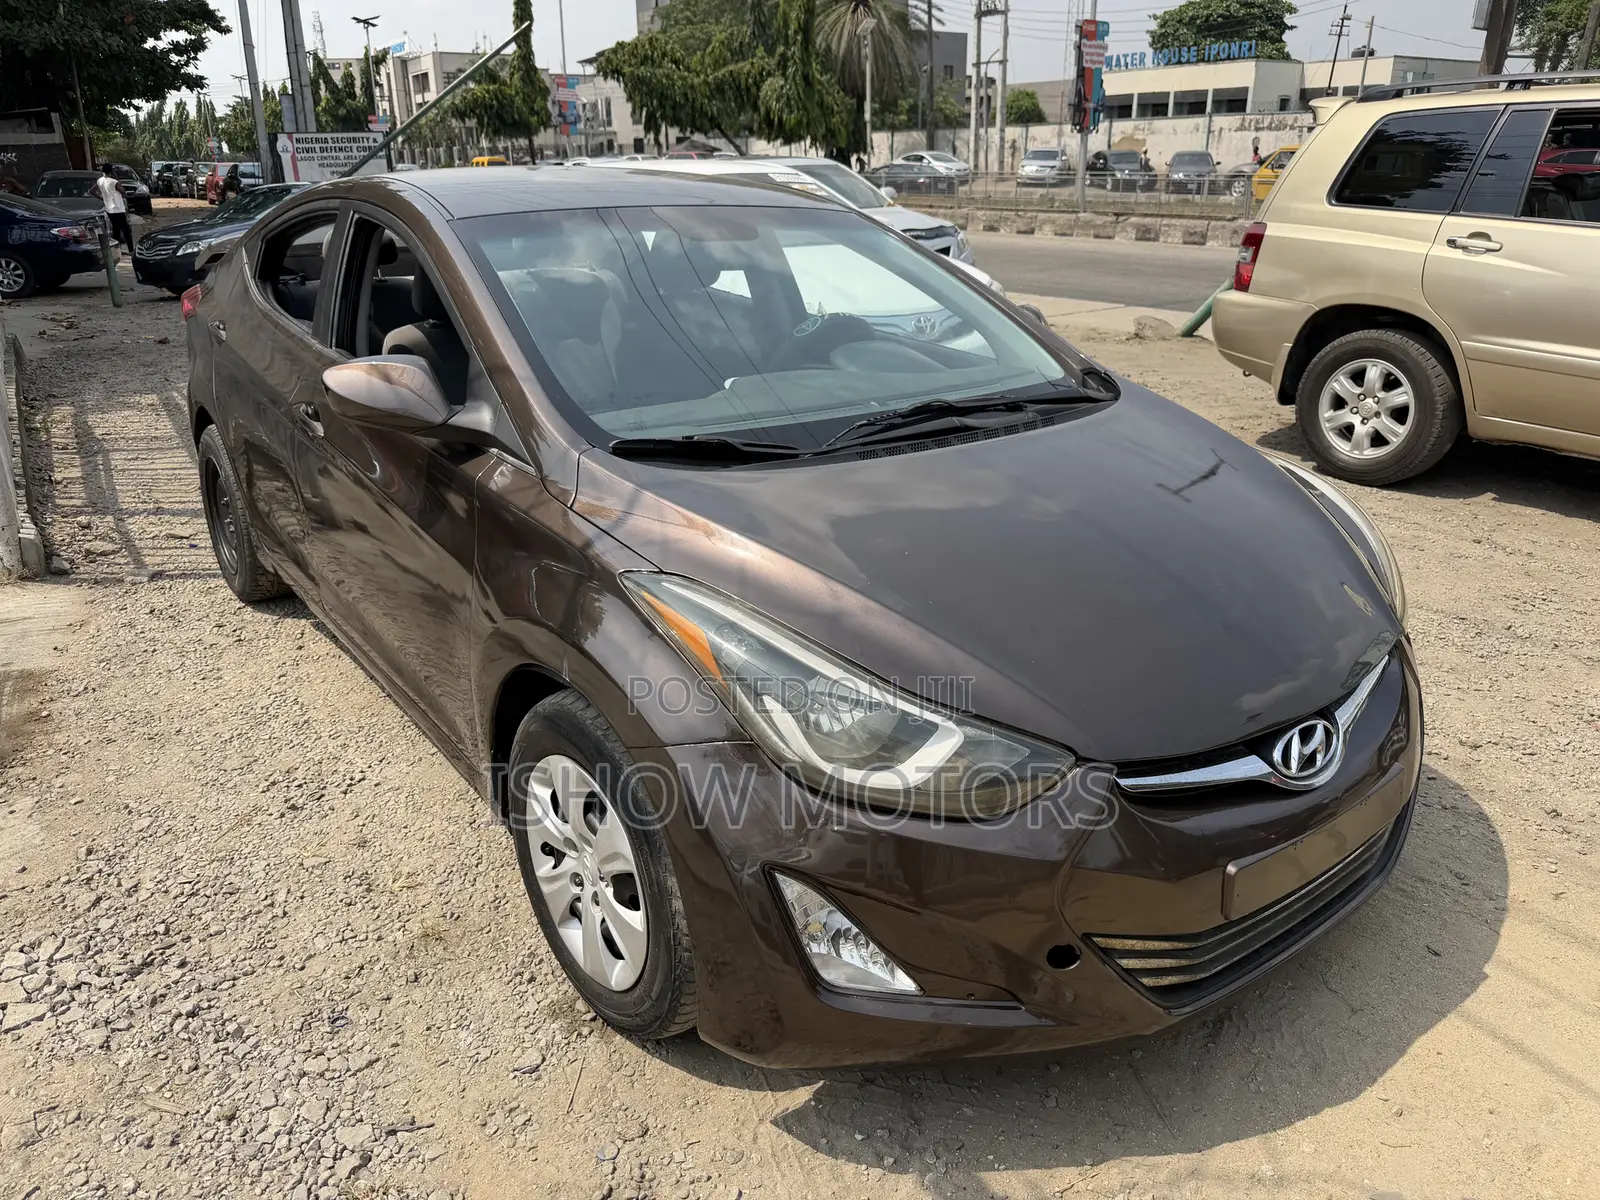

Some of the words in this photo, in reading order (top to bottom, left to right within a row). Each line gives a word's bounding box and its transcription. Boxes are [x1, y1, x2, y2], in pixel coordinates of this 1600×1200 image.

[1104, 51, 1146, 71] WATER
[1152, 46, 1198, 67] HOUSE
[1205, 40, 1256, 61] IPONRI
[295, 136, 329, 145] NIGERIA
[330, 136, 371, 144] SECURITY
[295, 146, 317, 154] CIVIL
[320, 145, 354, 154] DEFENCE
